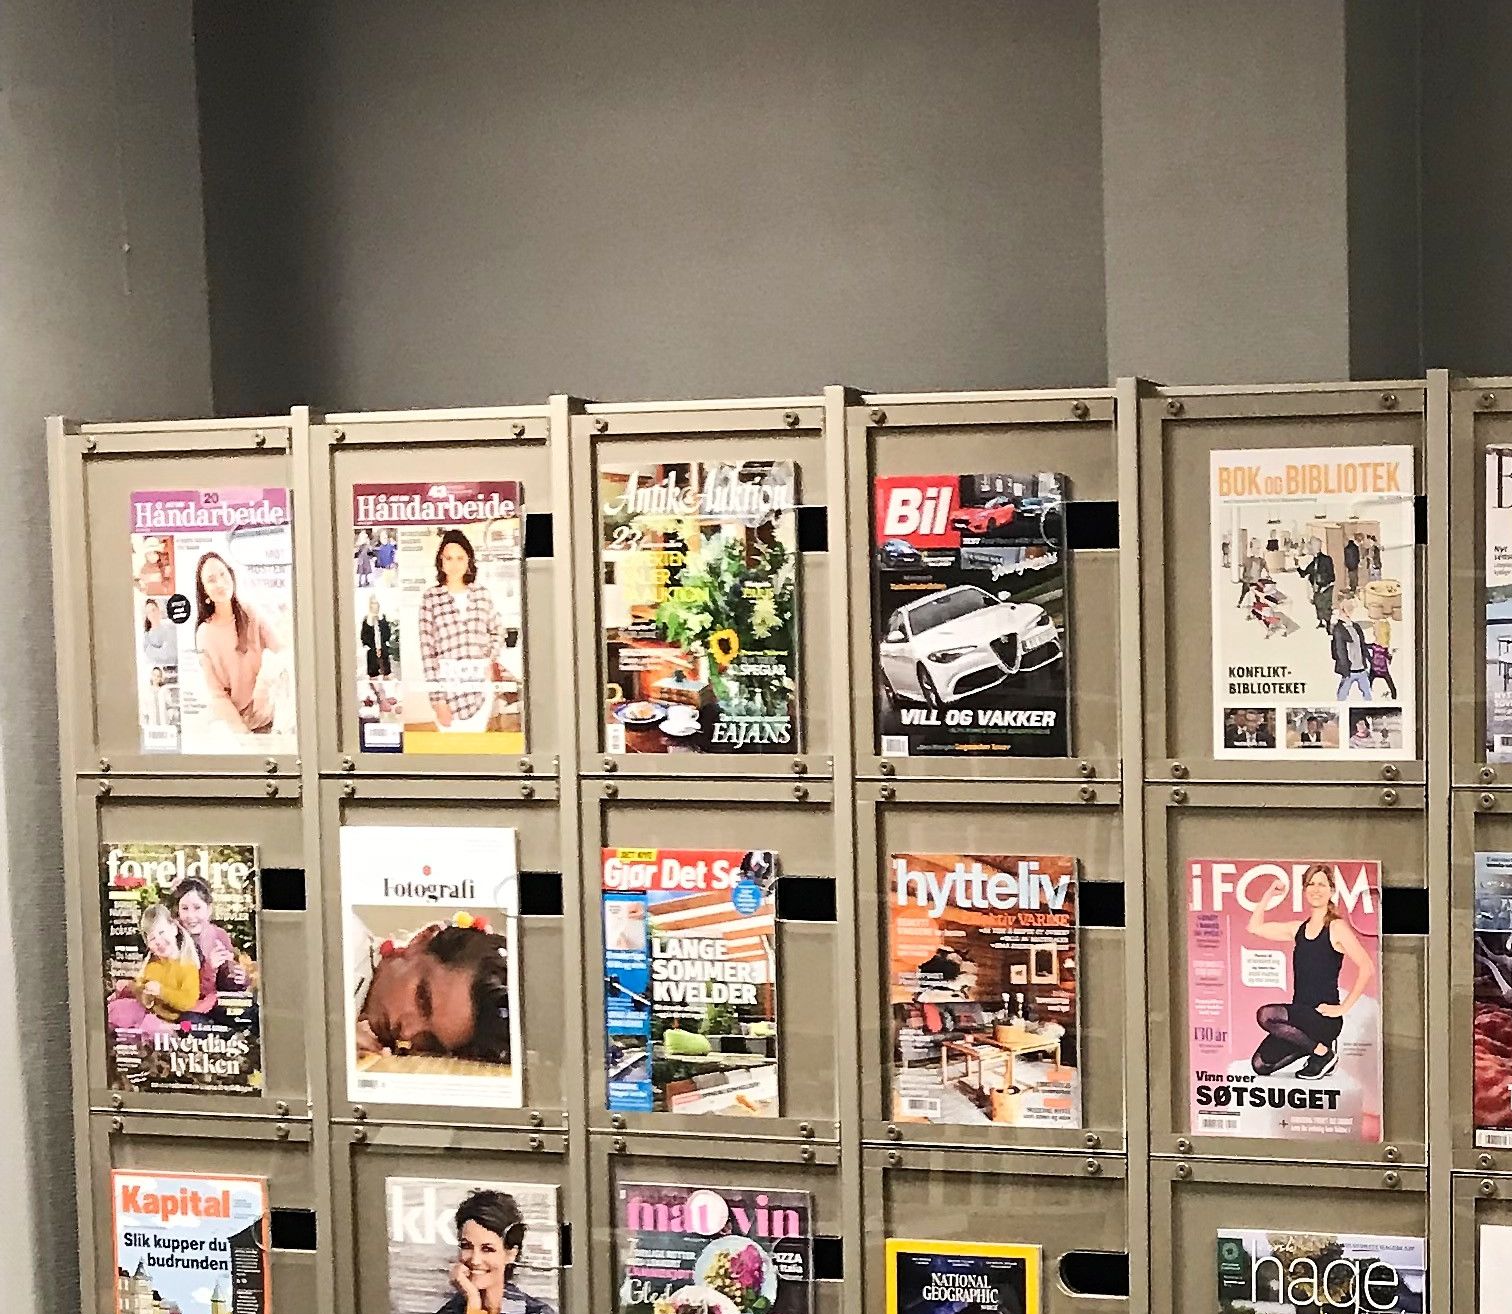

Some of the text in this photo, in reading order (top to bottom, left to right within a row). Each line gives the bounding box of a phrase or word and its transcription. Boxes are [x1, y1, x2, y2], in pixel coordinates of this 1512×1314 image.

[1218, 466, 1262, 497] BOK
[1285, 462, 1401, 495] BIBLIOTEK
[133, 500, 285, 528] Håndarbeide
[357, 493, 515, 521] Håndarbeide
[884, 487, 953, 536] Bil
[1228, 666, 1292, 680] KONFLIKT-
[1228, 682, 1307, 694] BIBLIOTEKET
[900, 709, 1056, 727] VILL OG VAKKER
[107, 849, 250, 892] foreldre
[660, 858, 707, 889] Det
[384, 878, 476, 902] Fotografi
[895, 859, 1071, 918] hytteliv
[652, 938, 729, 961] LANGE
[652, 981, 758, 1005] KVELDER
[170, 1053, 240, 1077] lykken
[1195, 1070, 1257, 1084] Vinn over
[1196, 1084, 1341, 1110] SØTSUGET
[121, 1184, 231, 1223] Kapital
[124, 1232, 228, 1252] Slik kupper du
[147, 1253, 229, 1271] budrunden
[931, 1272, 992, 1289] NATIONAL
[922, 1286, 999, 1304] GEOGRAPHIC
